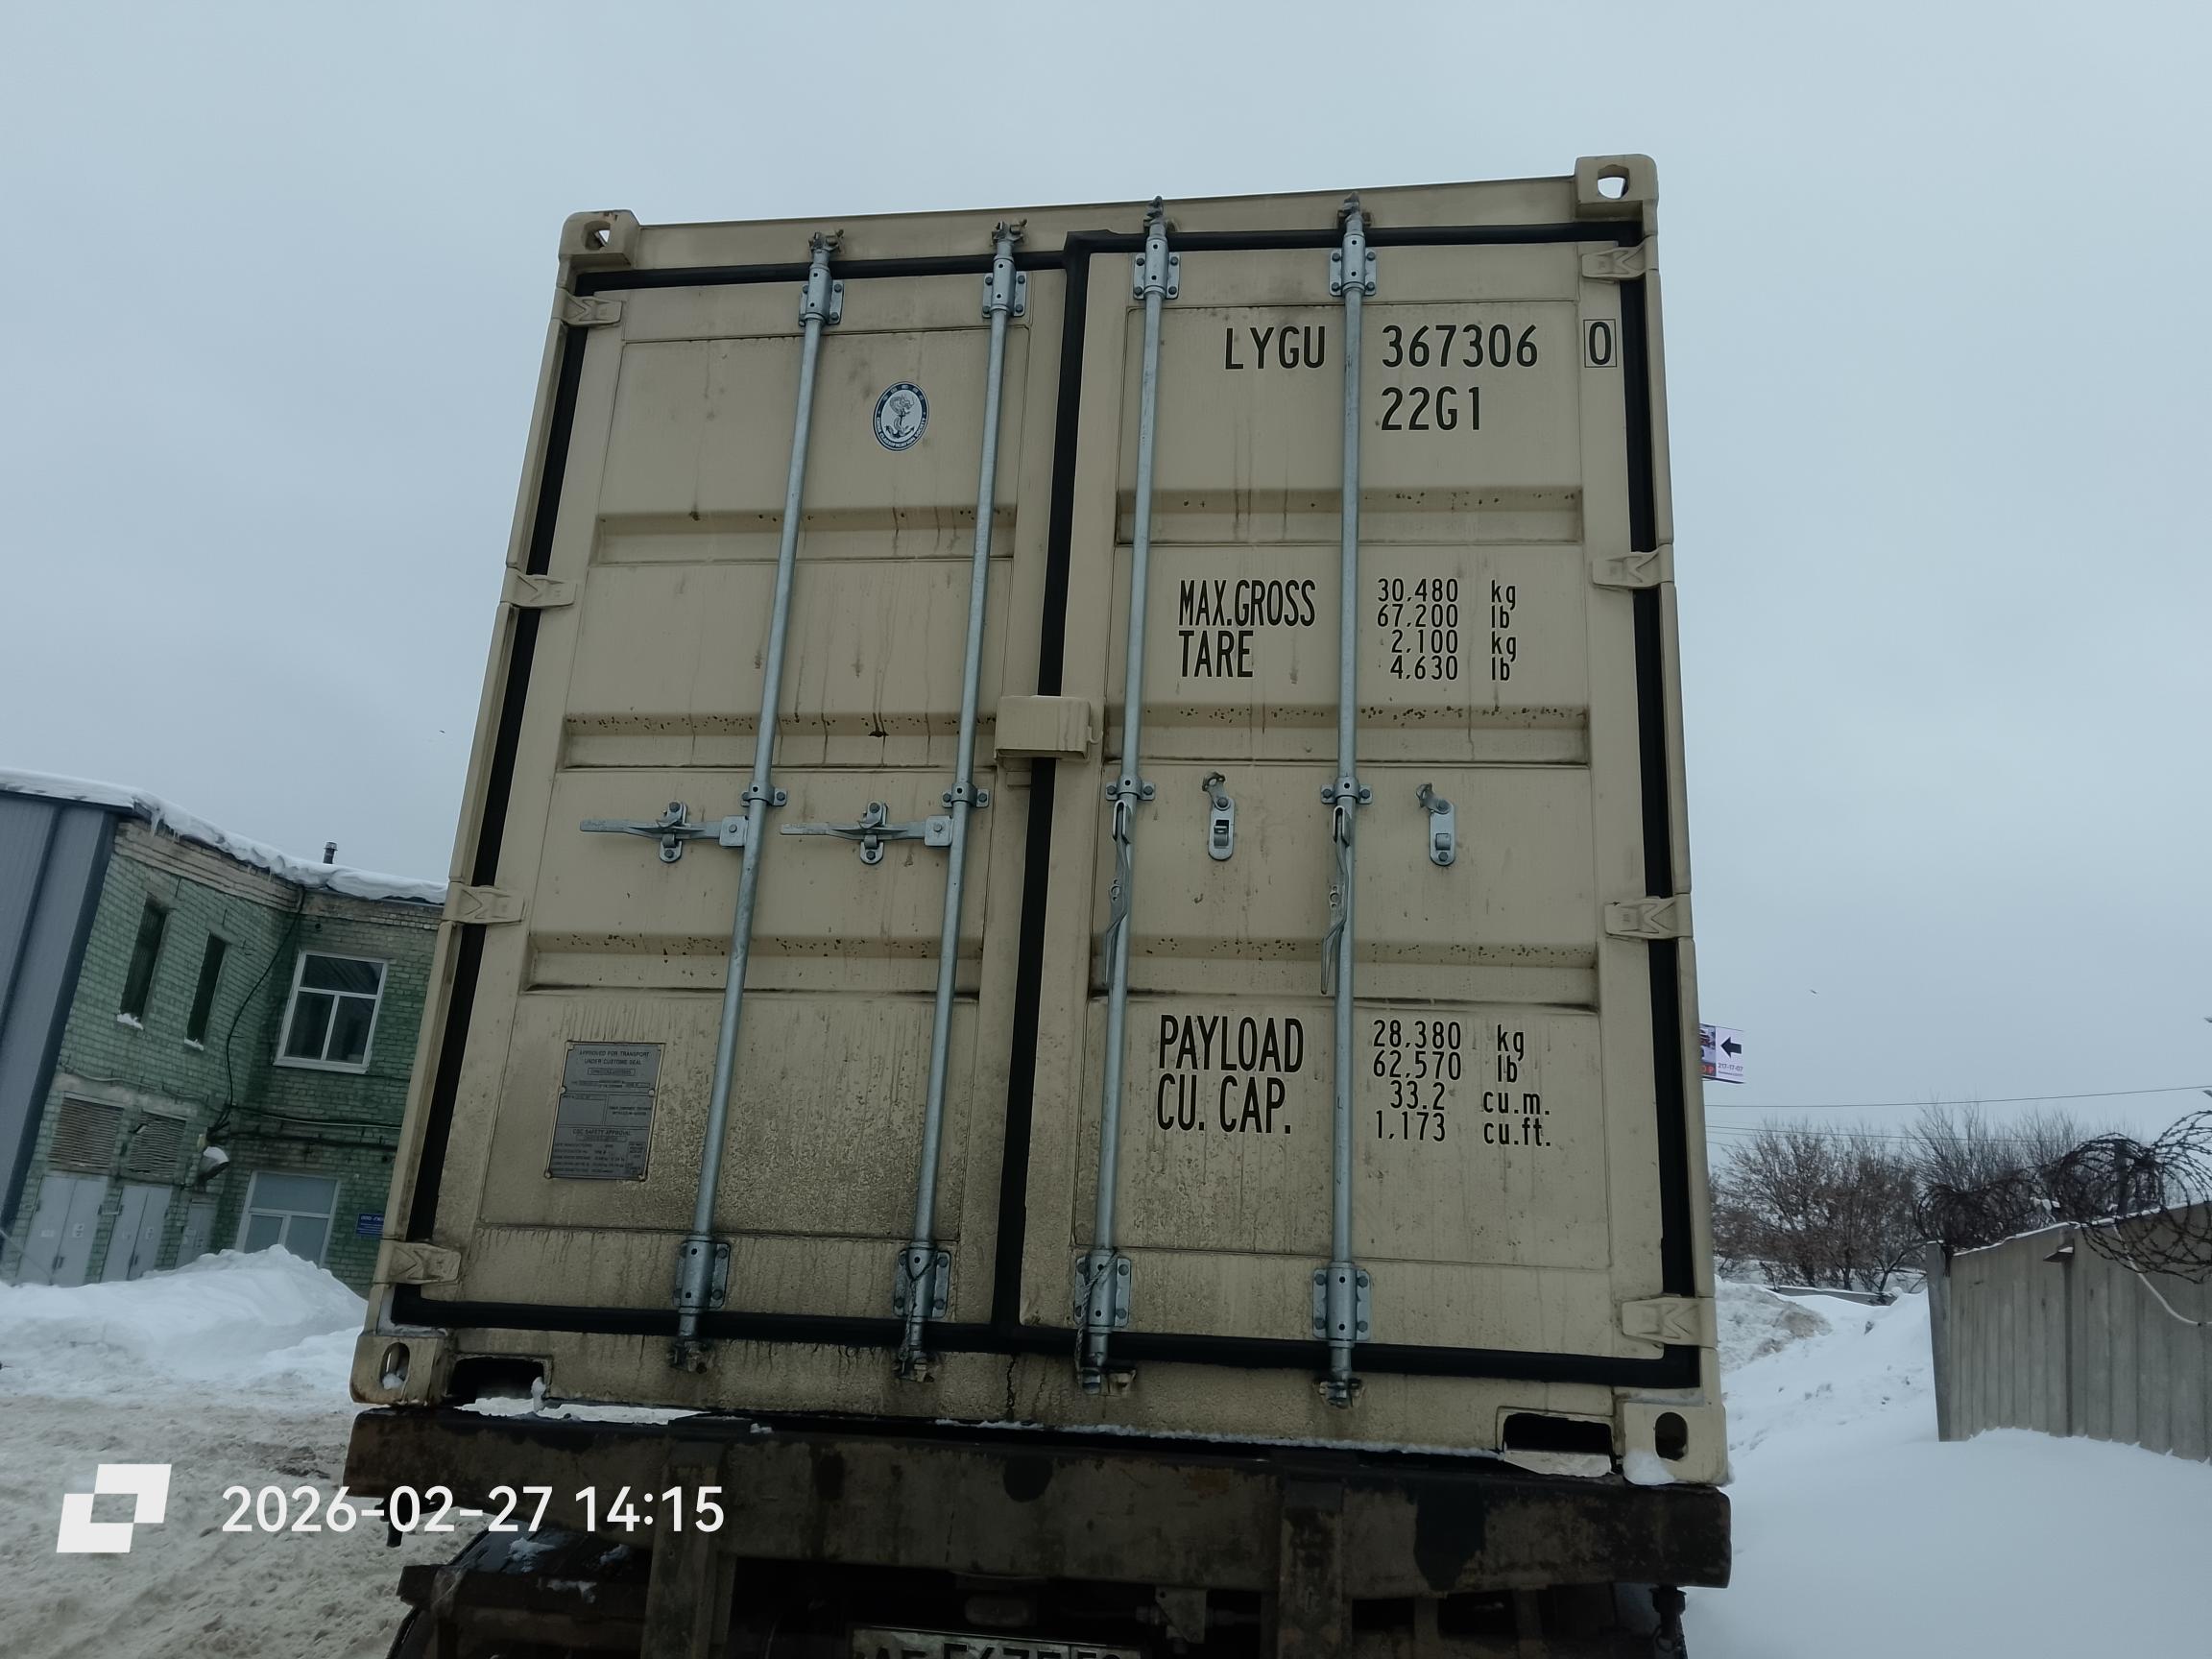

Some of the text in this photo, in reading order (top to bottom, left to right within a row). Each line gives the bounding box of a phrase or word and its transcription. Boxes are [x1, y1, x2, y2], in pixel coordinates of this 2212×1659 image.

[1225, 321, 1612, 370] LYGU 367306 0
[1381, 386, 1480, 431] 22G1
[1178, 579, 1315, 627] MAX.GROSS
[1491, 579, 1517, 610] kg
[1491, 608, 1510, 629] lb
[1178, 630, 1254, 678] TARE
[1491, 631, 1517, 661] kg
[1491, 658, 1510, 682] lb
[1159, 1014, 1304, 1073] PAYLOAD
[1497, 1023, 1525, 1061] kg
[1497, 1055, 1518, 1083] lb
[1157, 1073, 1292, 1135] CU. CAP.
[1389, 1080, 1445, 1111] 33.2
